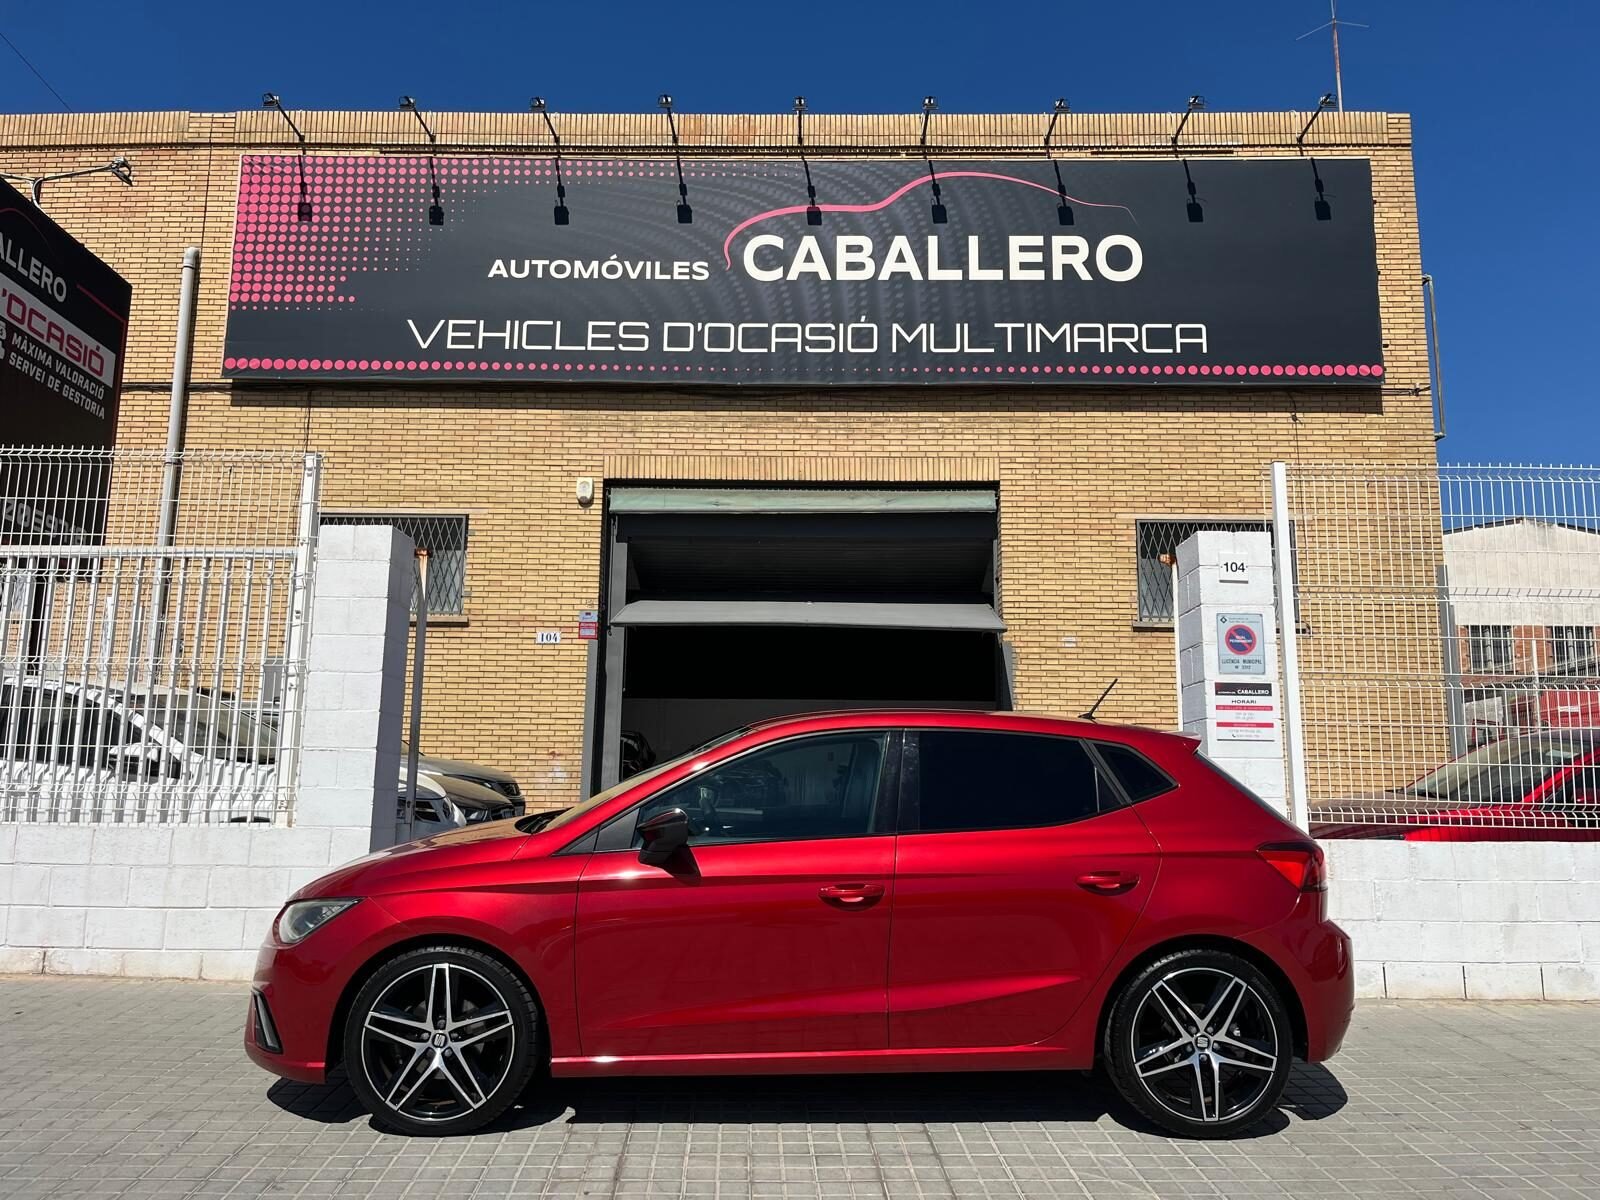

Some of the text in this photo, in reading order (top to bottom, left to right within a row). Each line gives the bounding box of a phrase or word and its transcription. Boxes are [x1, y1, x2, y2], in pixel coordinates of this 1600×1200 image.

[487, 234, 1143, 282] AUTOMÓVILES CABALLERO
[406, 319, 650, 351] VEHICLES
[662, 315, 879, 353] D'OCASIÓ
[9, 351, 105, 420] SERVEI DE GESTORIA
[55, 359, 105, 401] VALORACIÓ
[1223, 561, 1245, 573] 104
[541, 632, 557, 643] 104
